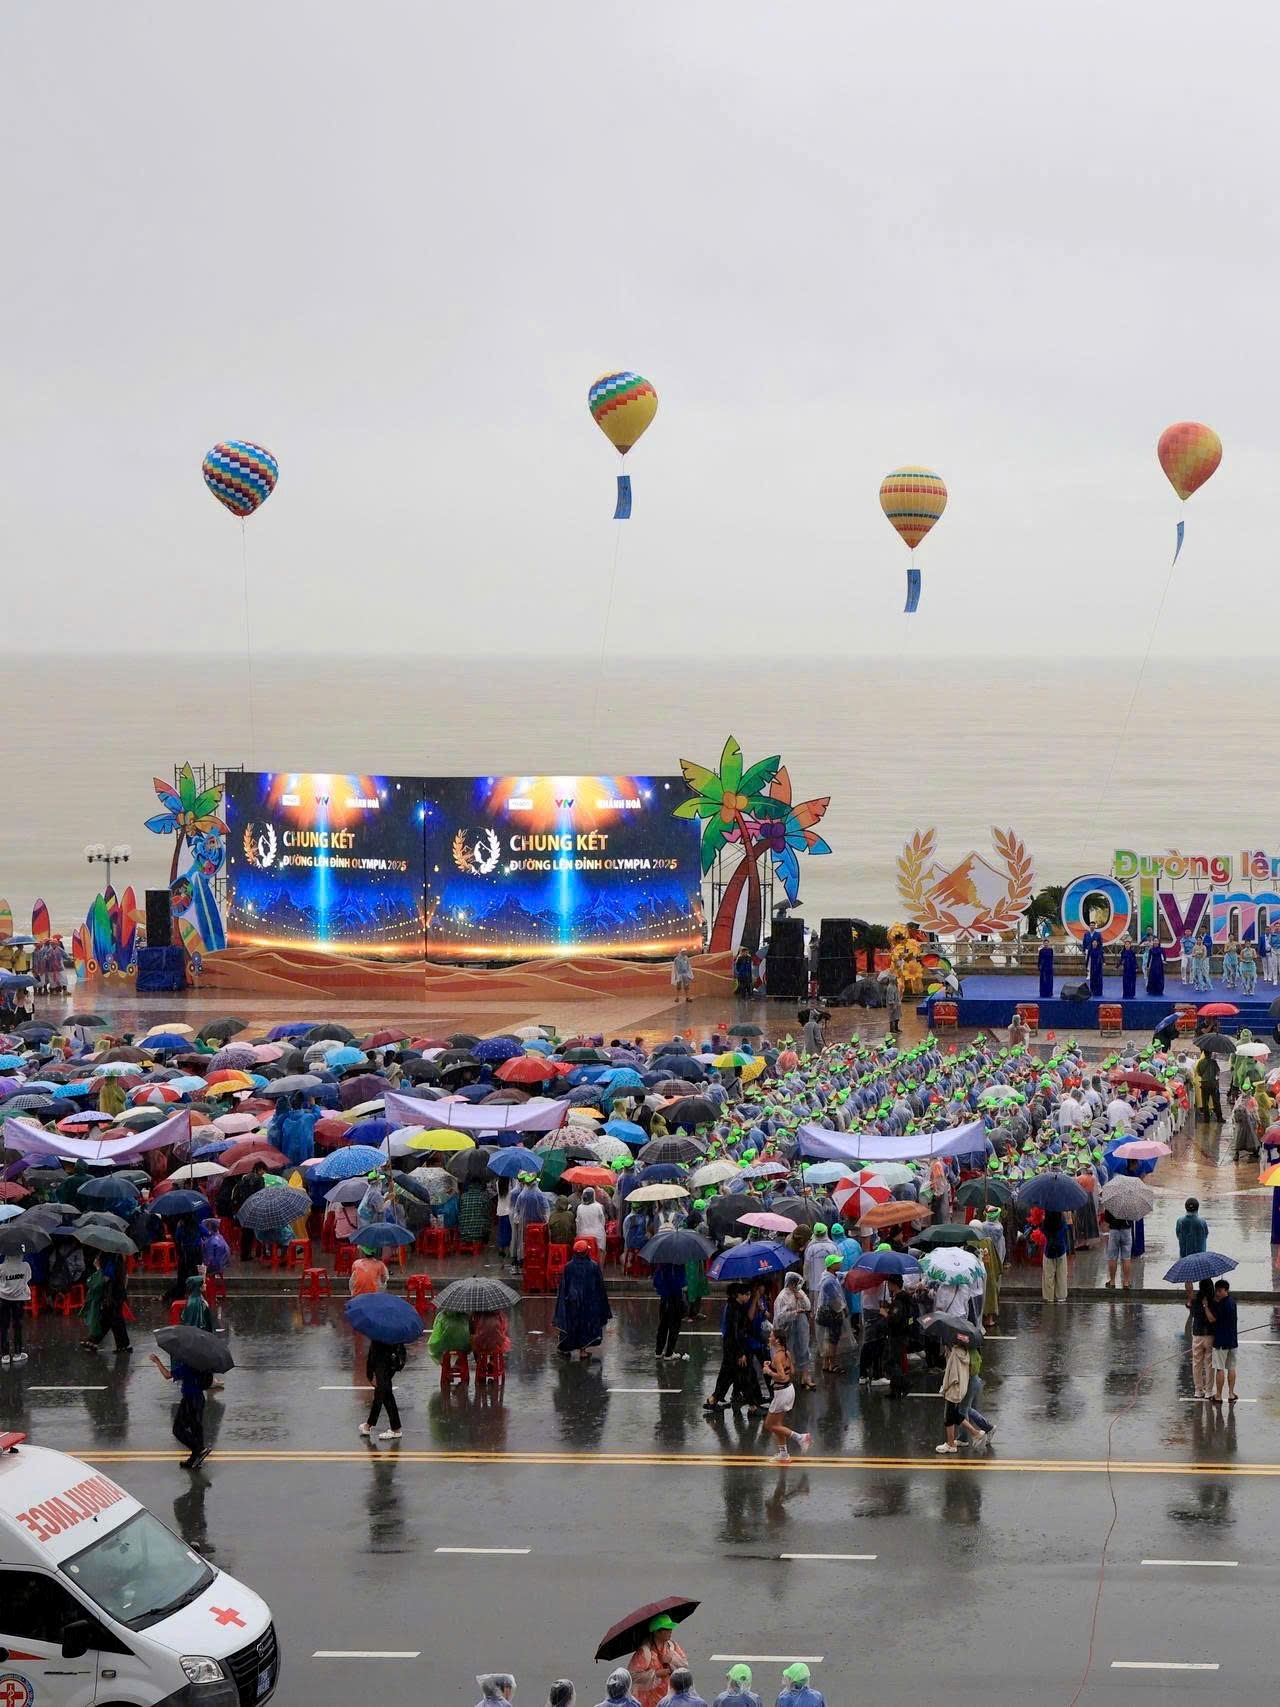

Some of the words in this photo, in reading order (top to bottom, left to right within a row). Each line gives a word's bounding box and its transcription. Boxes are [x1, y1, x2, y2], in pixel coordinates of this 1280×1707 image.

[315, 796, 329, 806] VTV
[555, 799, 574, 808] VTV
[283, 830, 328, 849] CHUNG
[331, 827, 355, 849] KẾT
[509, 834, 573, 851] CHUNG
[577, 829, 608, 851] KẾT
[351, 858, 387, 870] OLYMPIA
[604, 859, 650, 871] OLYMPIA
[1112, 848, 1233, 885] Đường
